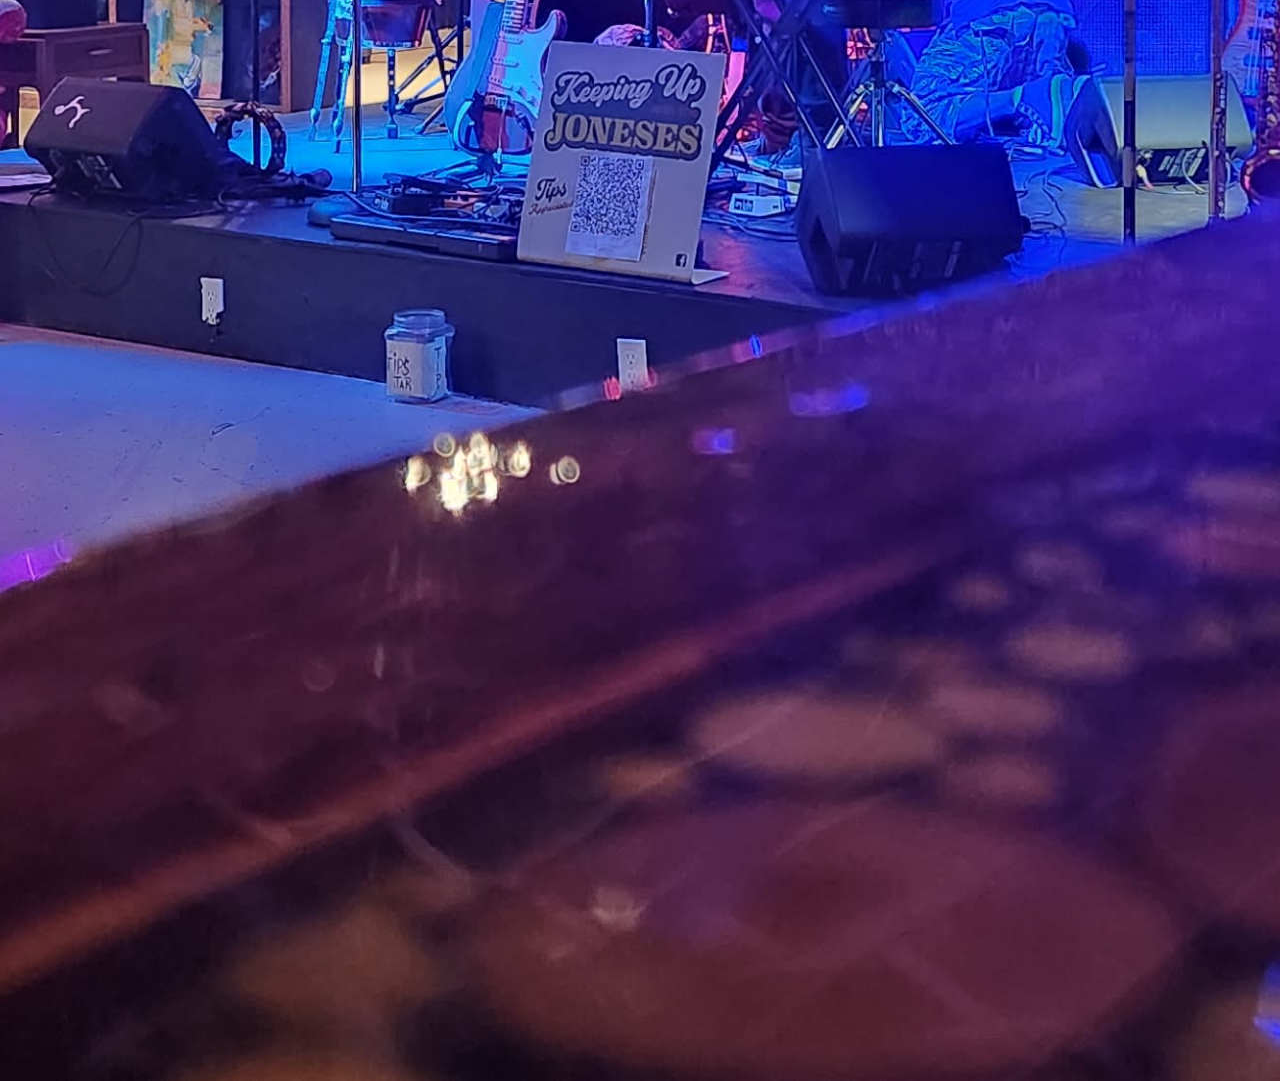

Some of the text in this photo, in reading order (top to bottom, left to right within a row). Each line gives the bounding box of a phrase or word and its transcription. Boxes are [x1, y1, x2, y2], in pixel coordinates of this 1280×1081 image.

[552, 64, 702, 109] Keeping Up
[545, 112, 701, 155] JONESES
[535, 177, 567, 203] Tips
